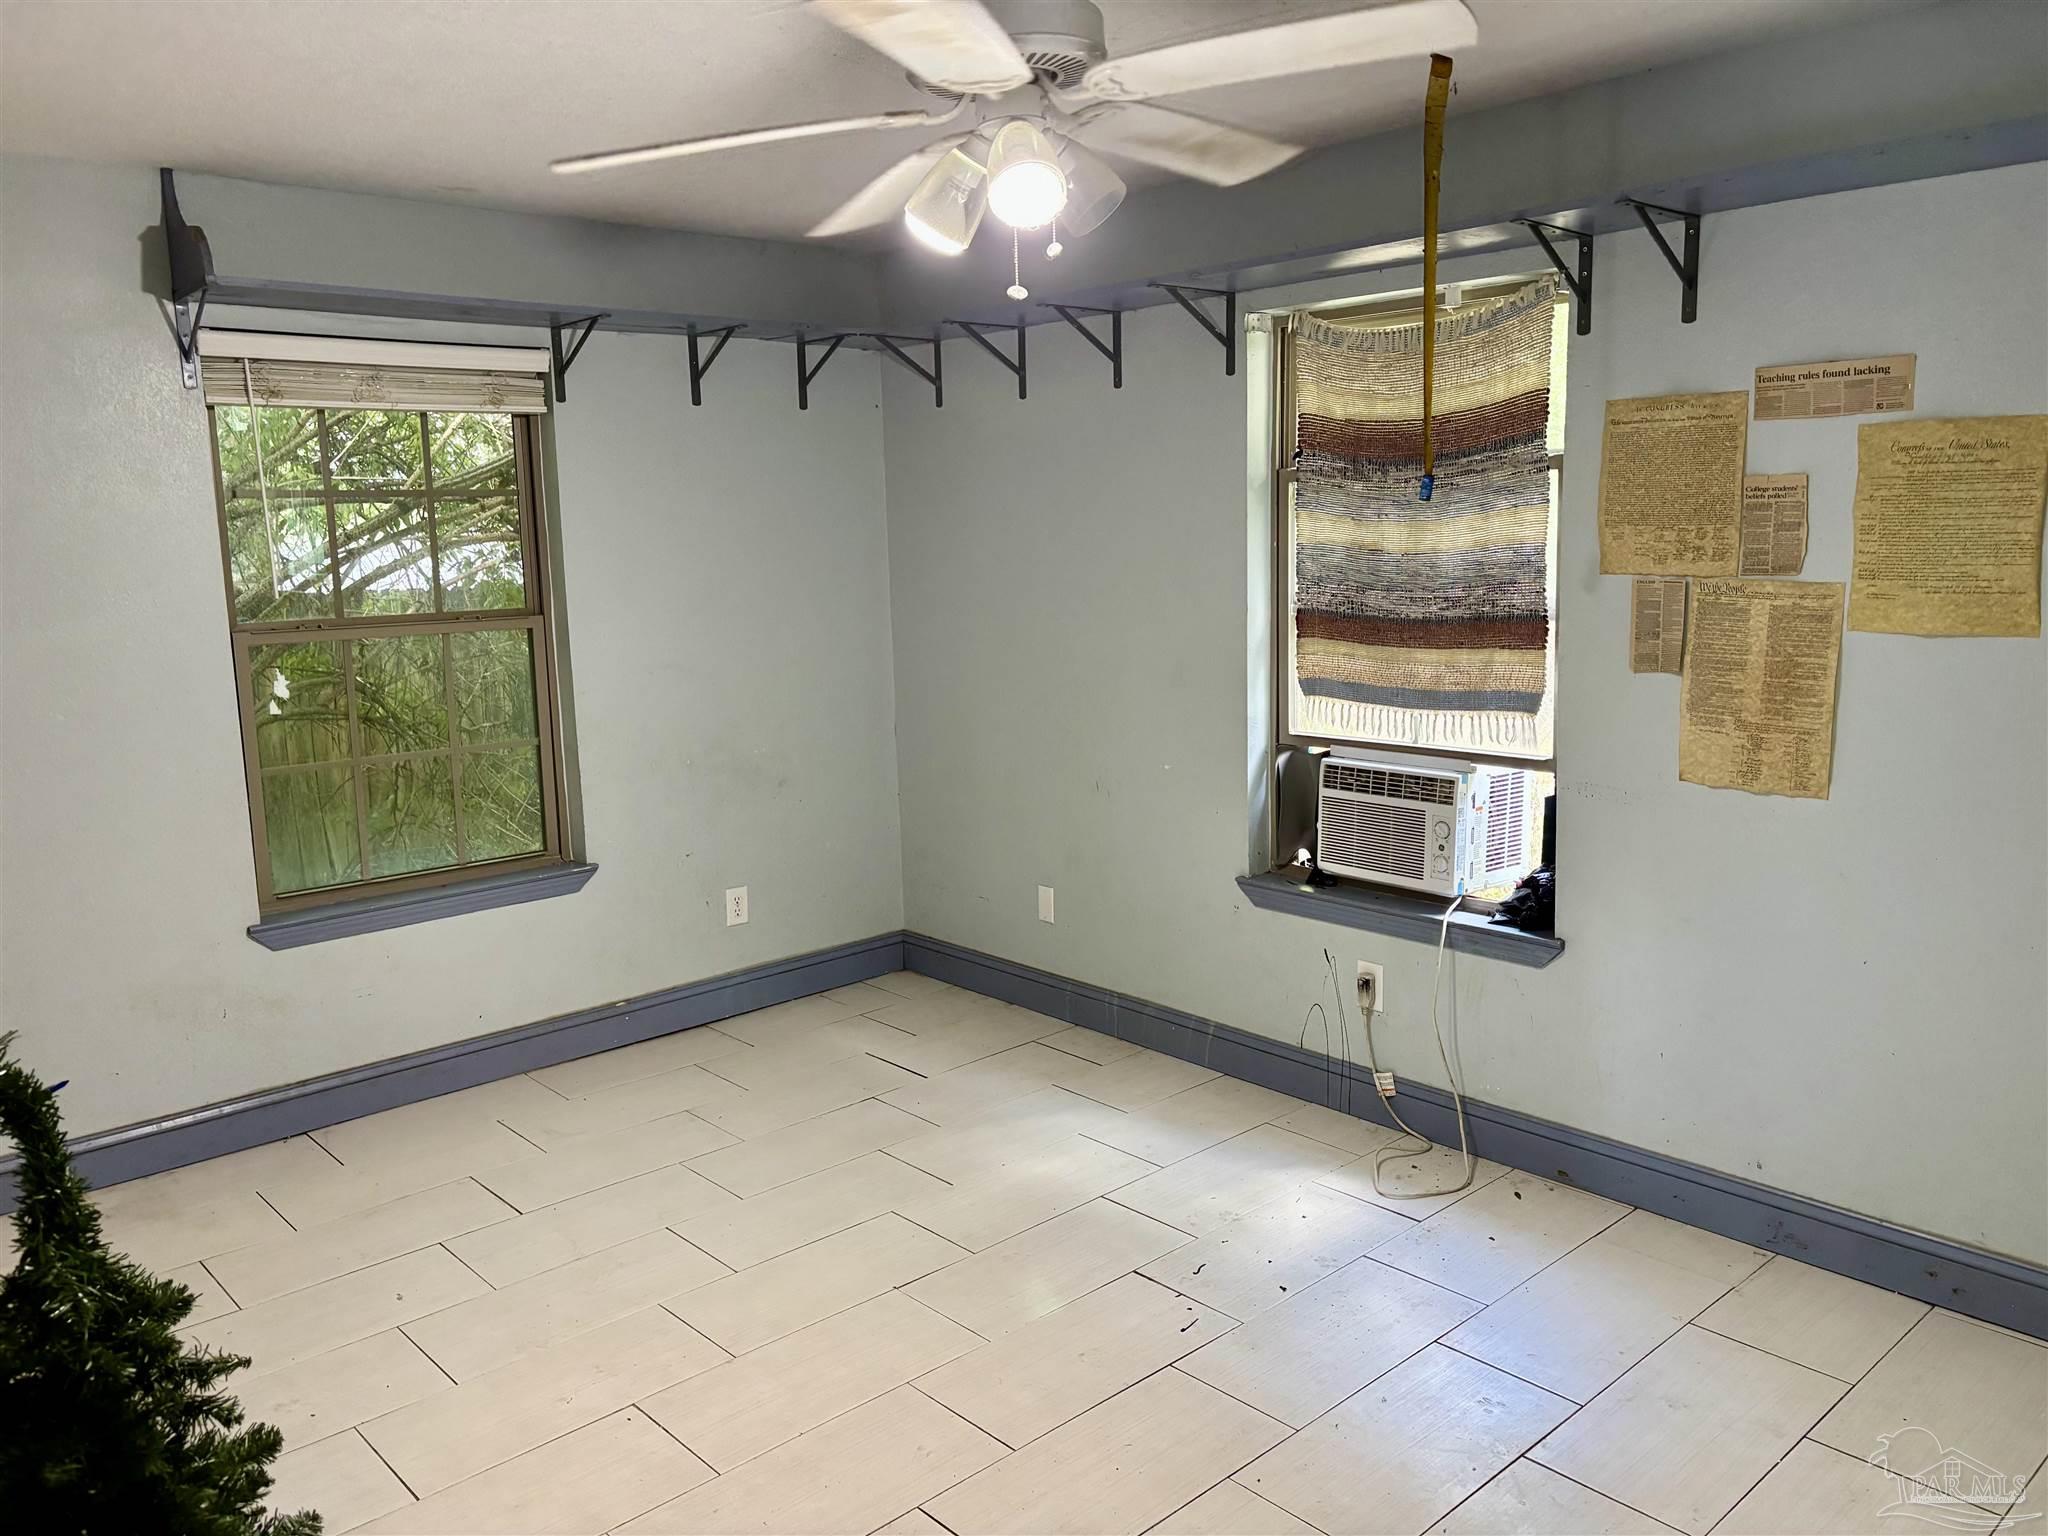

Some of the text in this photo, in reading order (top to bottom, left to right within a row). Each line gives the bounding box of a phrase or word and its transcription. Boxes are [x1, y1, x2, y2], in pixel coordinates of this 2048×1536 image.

[1756, 364, 1891, 384] Teaching rules found lacking
[1745, 492, 1766, 500] beliefs
[1767, 492, 1787, 500] polled
